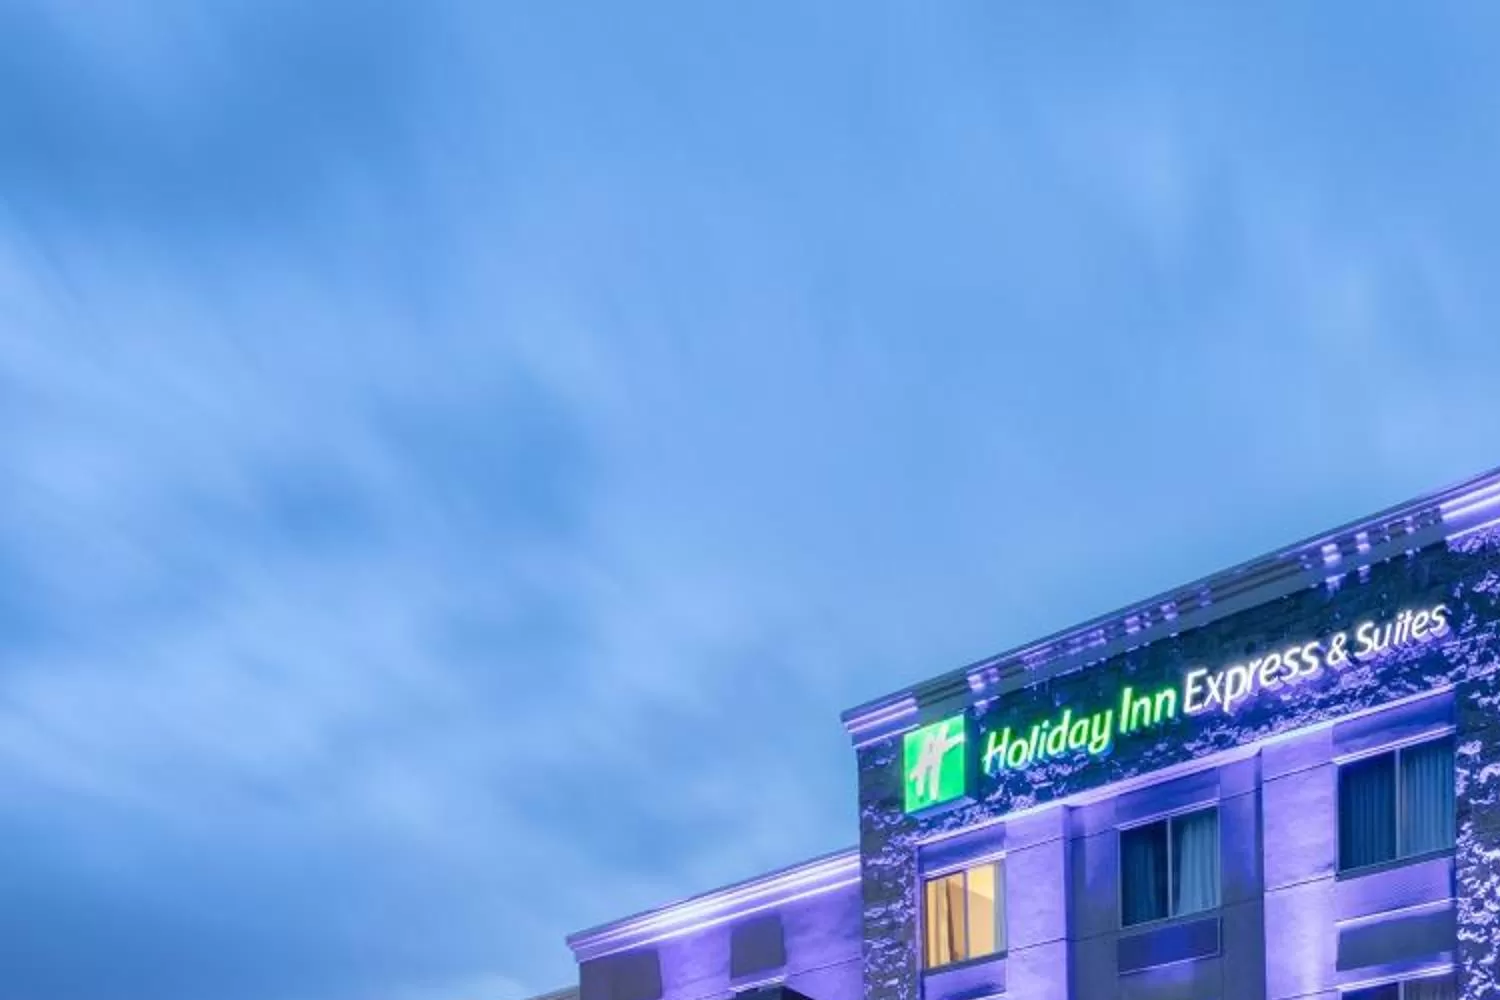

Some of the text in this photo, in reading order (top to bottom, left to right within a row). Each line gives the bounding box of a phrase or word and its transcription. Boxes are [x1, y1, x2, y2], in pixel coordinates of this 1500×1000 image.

[983, 604, 1446, 774] Holiday Inn Express & Suites
